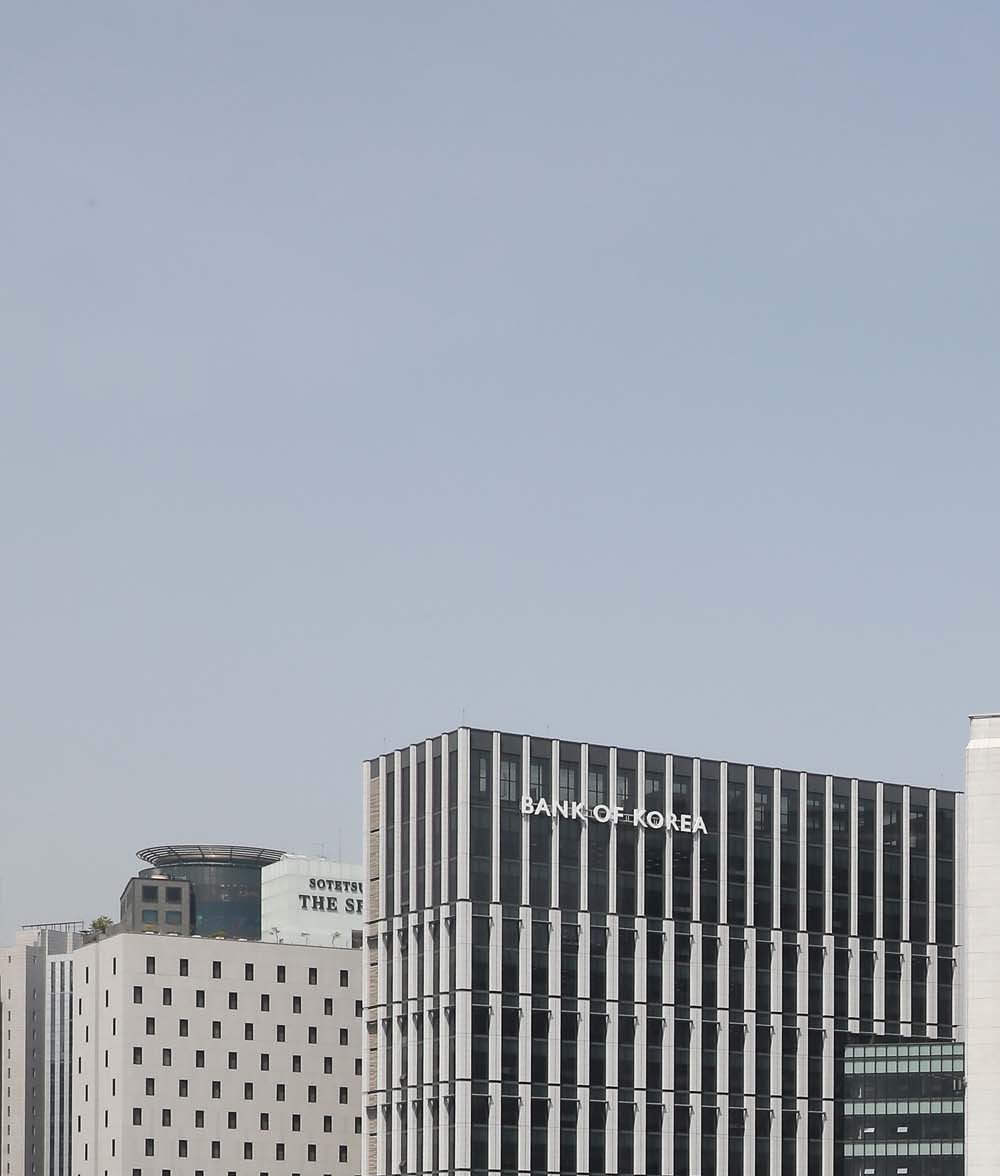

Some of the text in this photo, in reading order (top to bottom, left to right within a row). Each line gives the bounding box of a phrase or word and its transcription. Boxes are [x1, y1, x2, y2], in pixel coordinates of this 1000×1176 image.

[521, 795, 708, 834] BANK OF KOREA
[299, 895, 338, 911] THE
